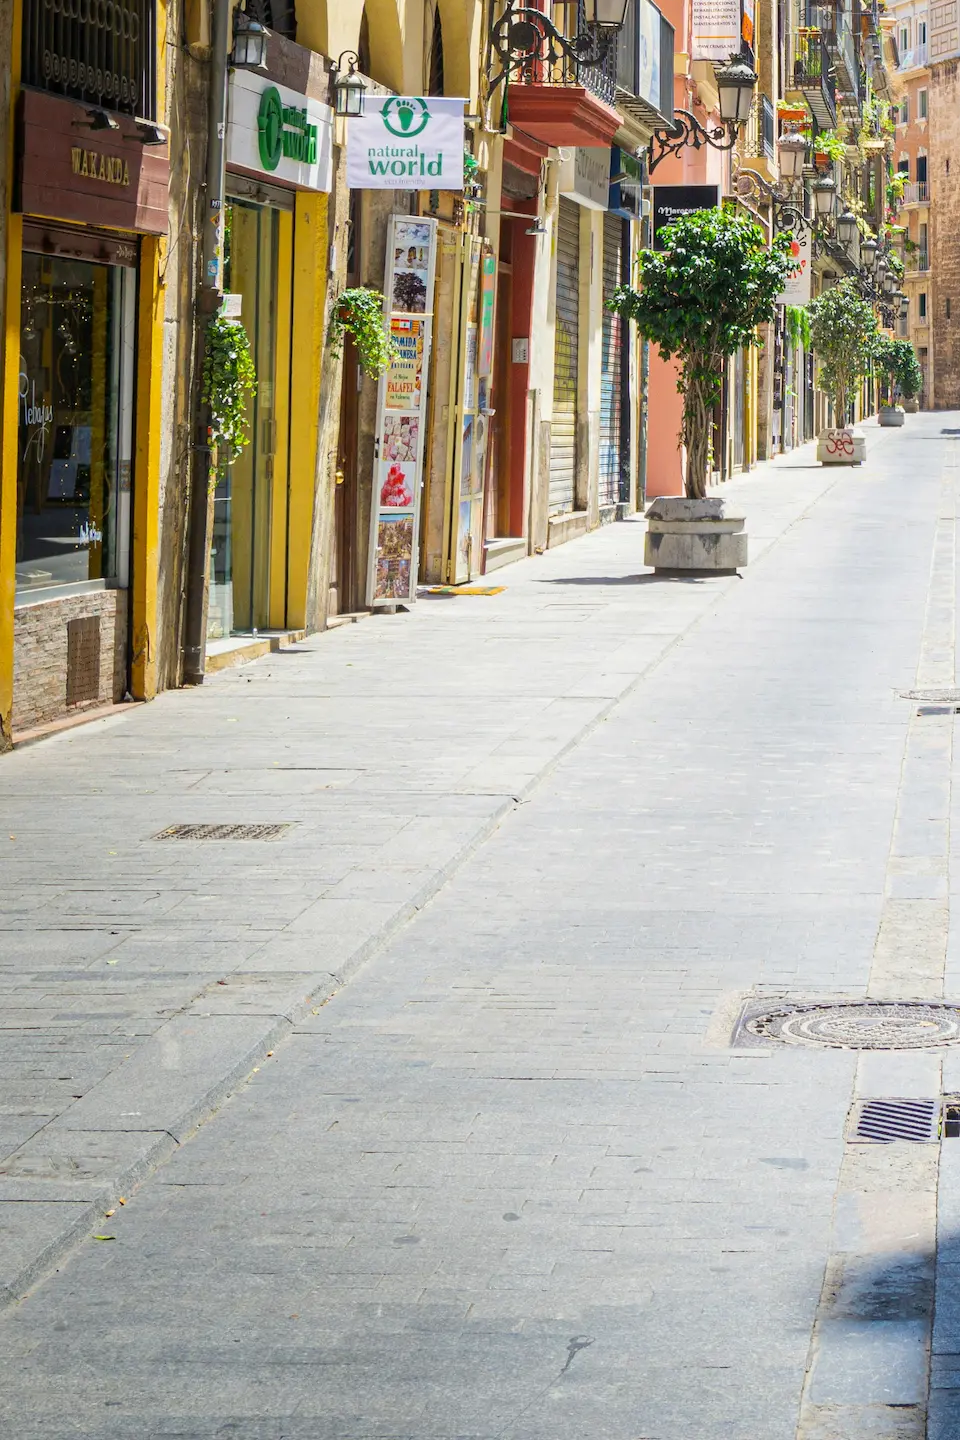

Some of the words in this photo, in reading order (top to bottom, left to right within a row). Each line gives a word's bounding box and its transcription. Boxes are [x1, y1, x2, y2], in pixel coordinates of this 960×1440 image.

[368, 144, 418, 157] natural
[71, 146, 130, 186] WAKANDA
[368, 153, 442, 176] world
[387, 382, 414, 392] FALAFEL
